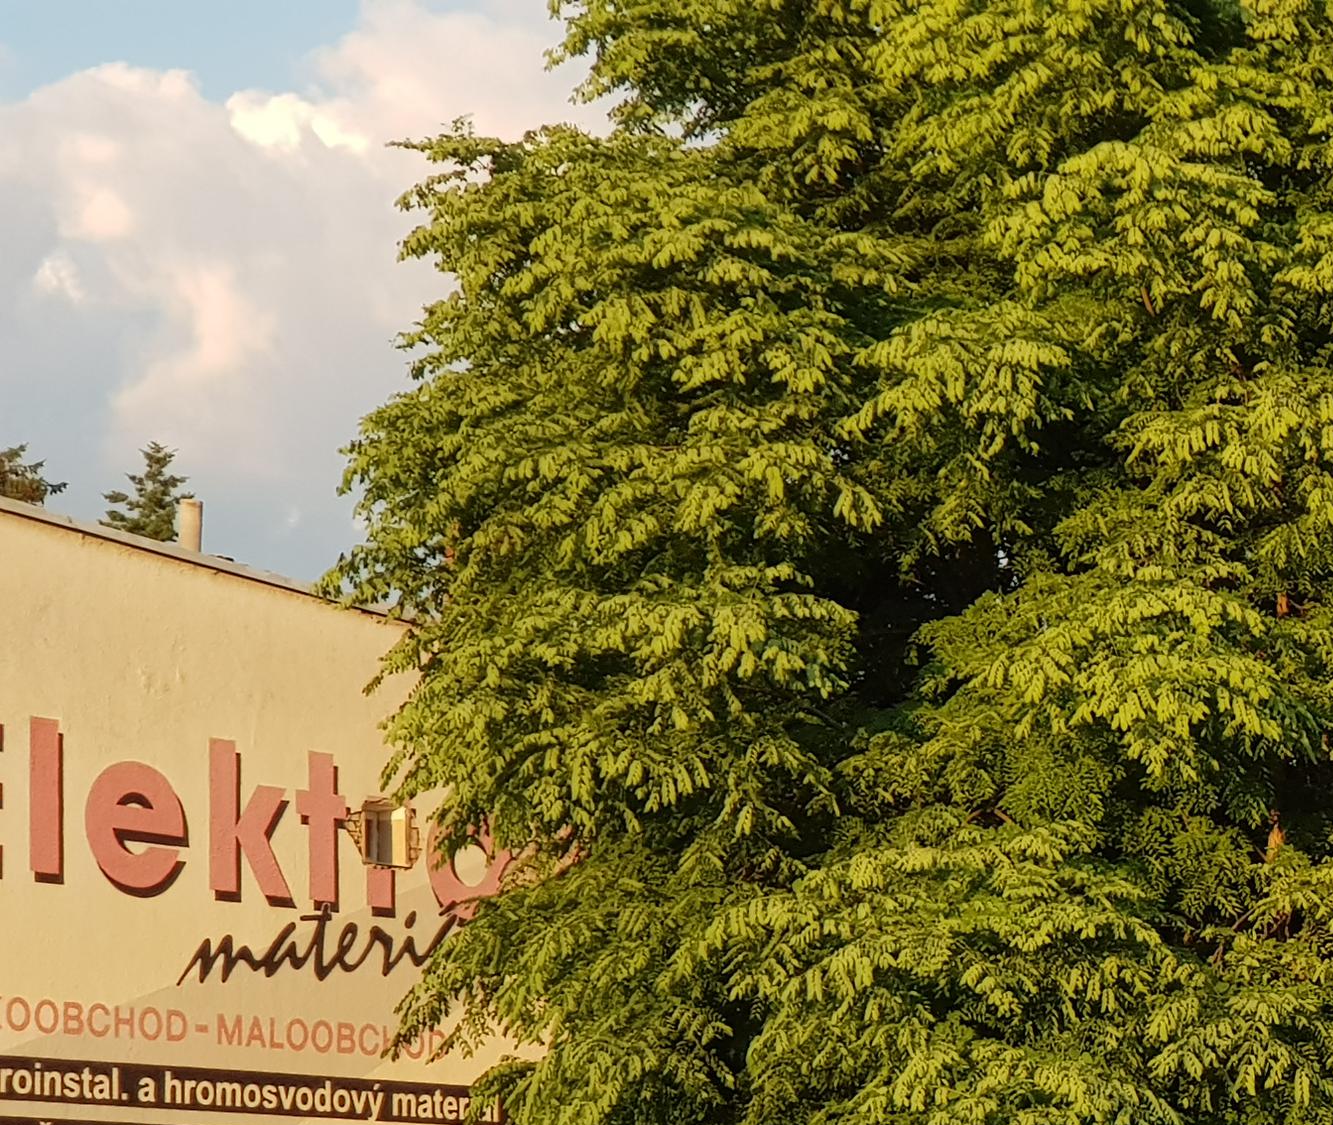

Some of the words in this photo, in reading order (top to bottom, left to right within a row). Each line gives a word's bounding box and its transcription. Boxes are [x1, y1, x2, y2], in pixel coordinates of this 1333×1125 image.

[0, 716, 512, 920] lekto
[0, 996, 188, 1042] OOBCHOD
[137, 1076, 157, 1103] a
[164, 1070, 384, 1121] hromosvodový
[391, 1088, 501, 1123] materal
